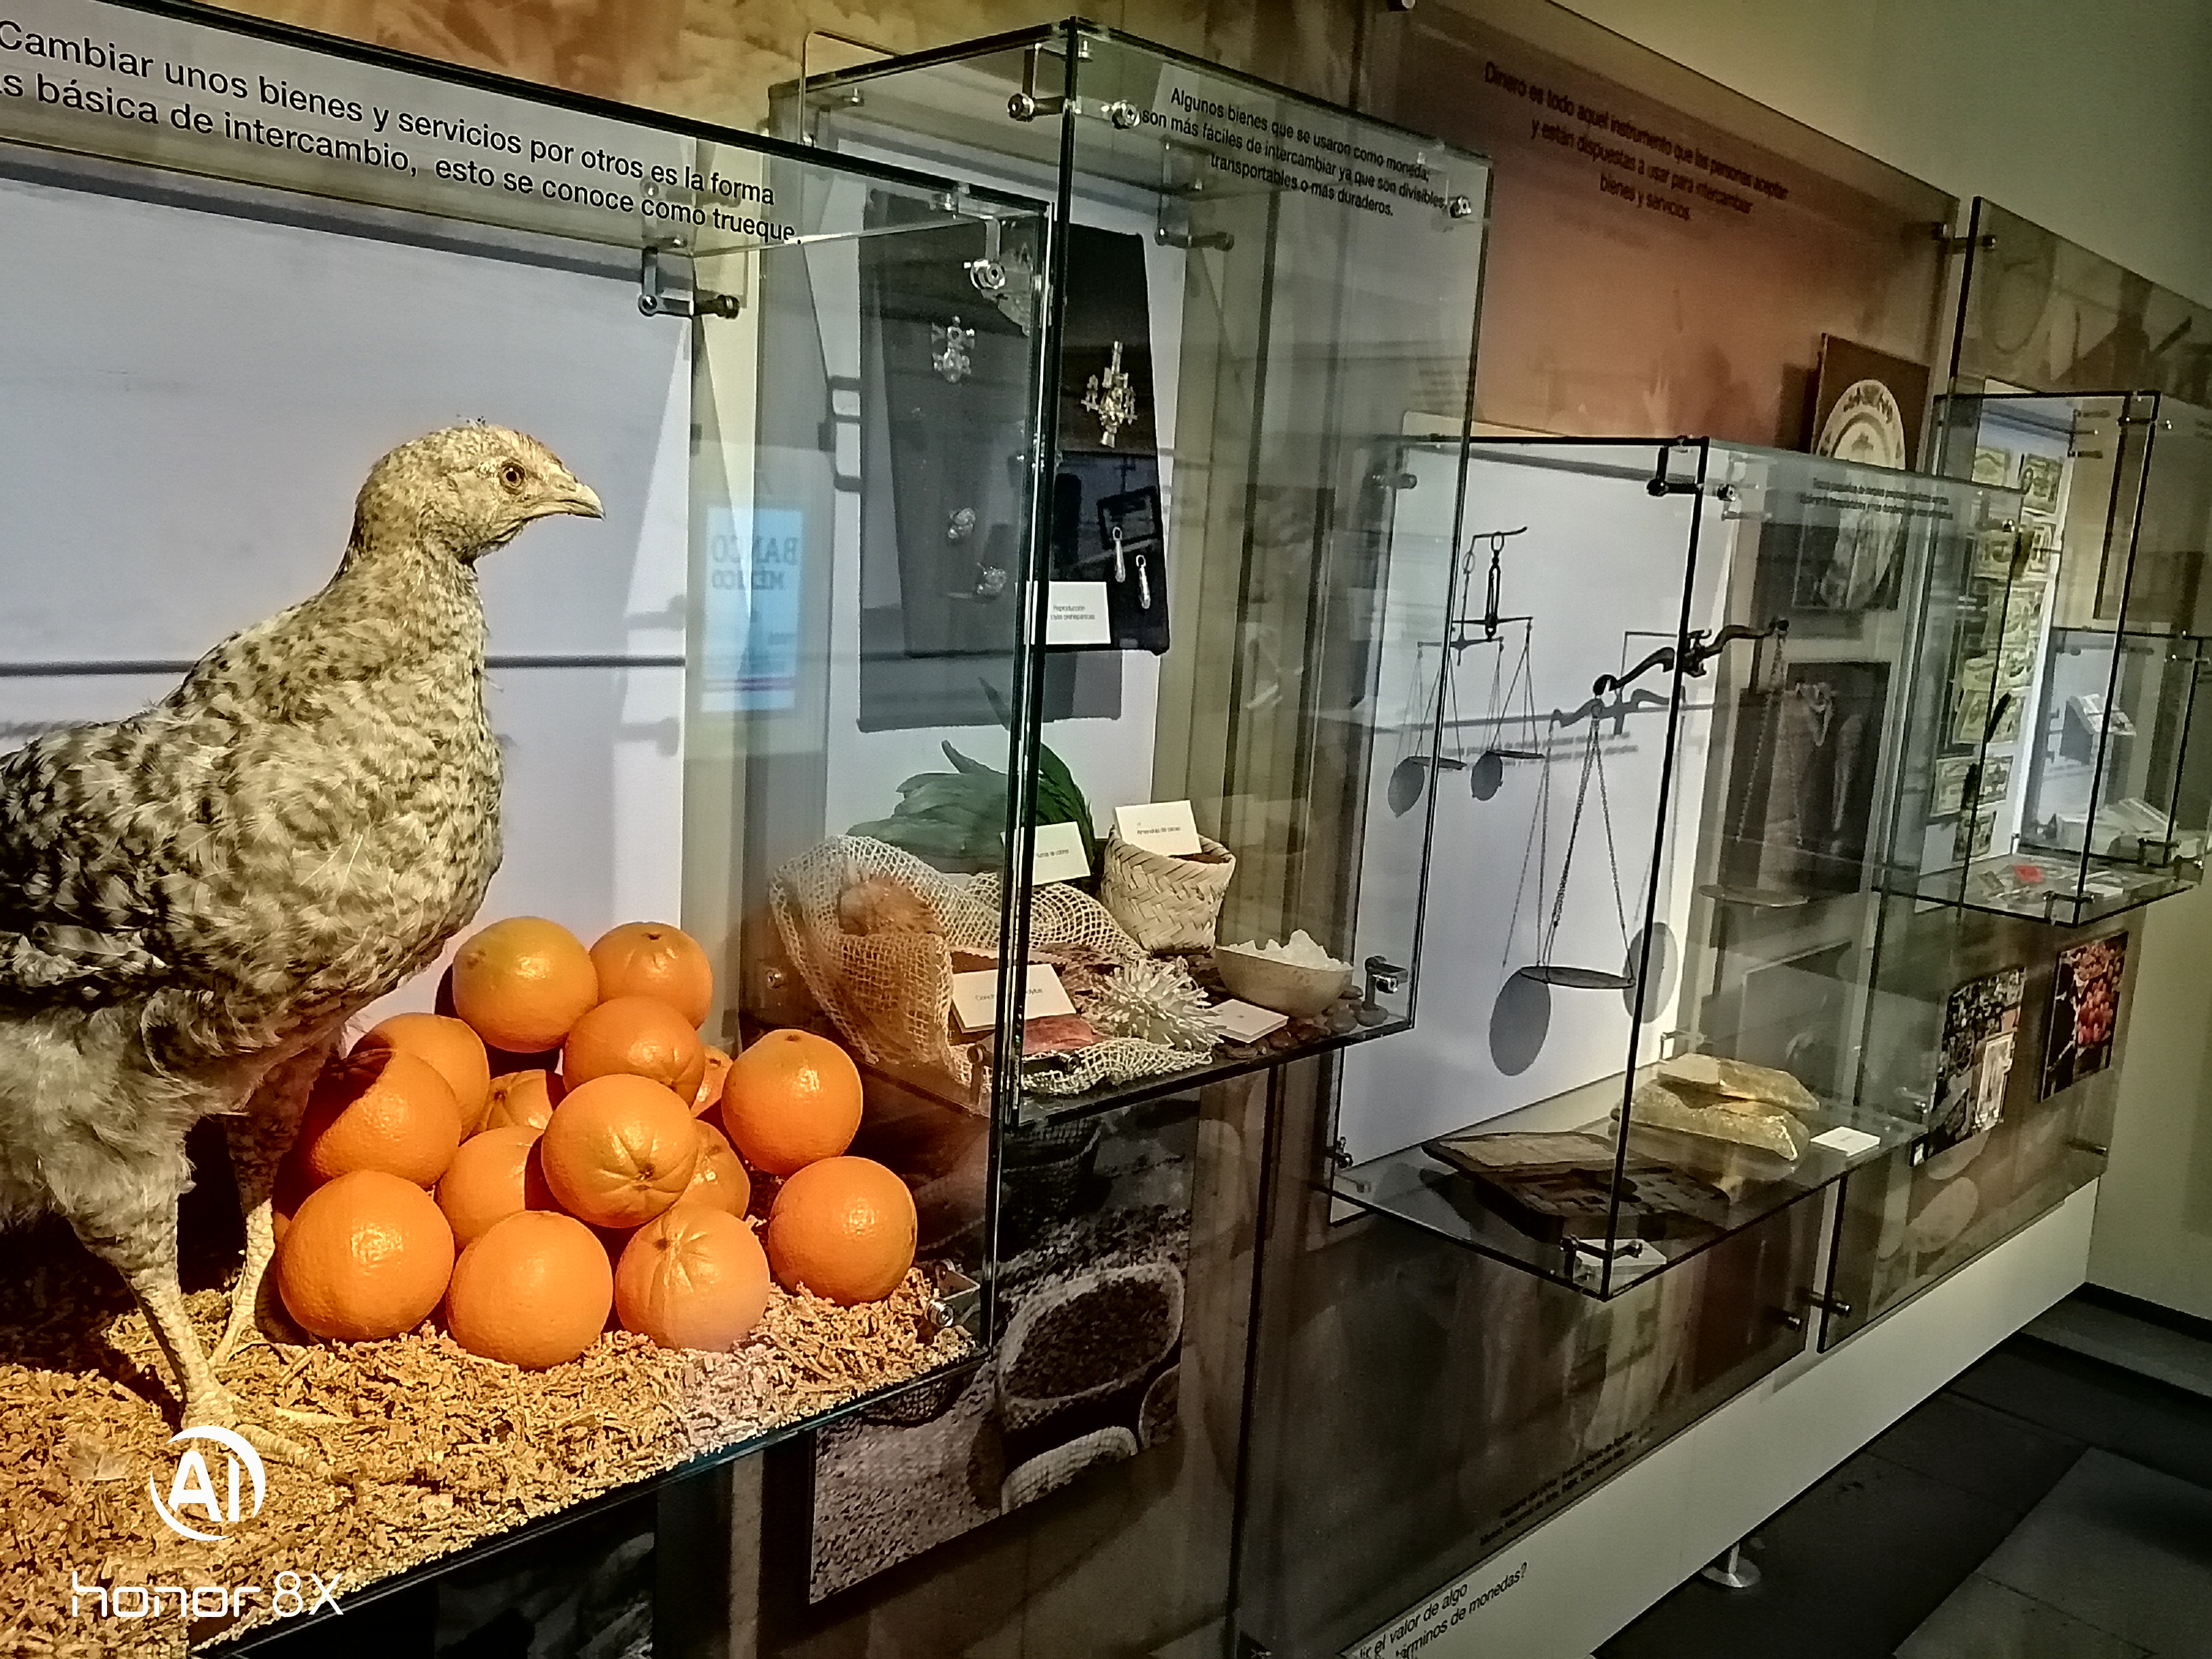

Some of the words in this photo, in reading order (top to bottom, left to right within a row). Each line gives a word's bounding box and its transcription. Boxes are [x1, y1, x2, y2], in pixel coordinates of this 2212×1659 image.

[0, 20, 153, 77] Cambiar
[165, 61, 247, 98] unos
[259, 76, 363, 121] bienes
[372, 107, 390, 133] y
[398, 110, 521, 154] servicios
[530, 138, 575, 165] por
[581, 147, 643, 179] otros
[651, 165, 678, 185] es
[684, 166, 704, 192] la
[710, 176, 775, 206] forma
[1170, 87, 1225, 118] Algunos
[1227, 104, 1268, 131] bienes
[1271, 121, 1294, 140] que
[1296, 128, 1311, 144] se
[1313, 134, 1351, 157] usaron
[1353, 146, 1384, 167] como
[1547, 89, 1574, 117] todo
[0, 74, 24, 97] s
[37, 73, 159, 125] básica
[170, 104, 213, 134] de
[224, 112, 418, 178] intercambio,
[435, 159, 495, 187] esto
[504, 171, 533, 194] se
[541, 179, 634, 212] conoce
[642, 197, 706, 225] como
[712, 207, 804, 245] trueque.
[1141, 110, 1167, 128] son
[1170, 117, 1199, 137] más
[1202, 122, 1243, 150] fáciles
[1246, 136, 1262, 155] de
[1265, 140, 1336, 176] intercambiar
[1338, 165, 1353, 182] ya
[1354, 171, 1376, 188] que
[1377, 177, 1397, 194] son
[1210, 152, 1297, 190] transportables
[1300, 179, 1309, 193] o
[1337, 187, 1394, 217] duraderos.
[1390, 1614, 1422, 1644] valor
[1423, 1601, 1440, 1622] de
[1441, 1583, 1469, 1611] algo
[1450, 1607, 1467, 1627] de
[1469, 1561, 1528, 1615] monedas?
